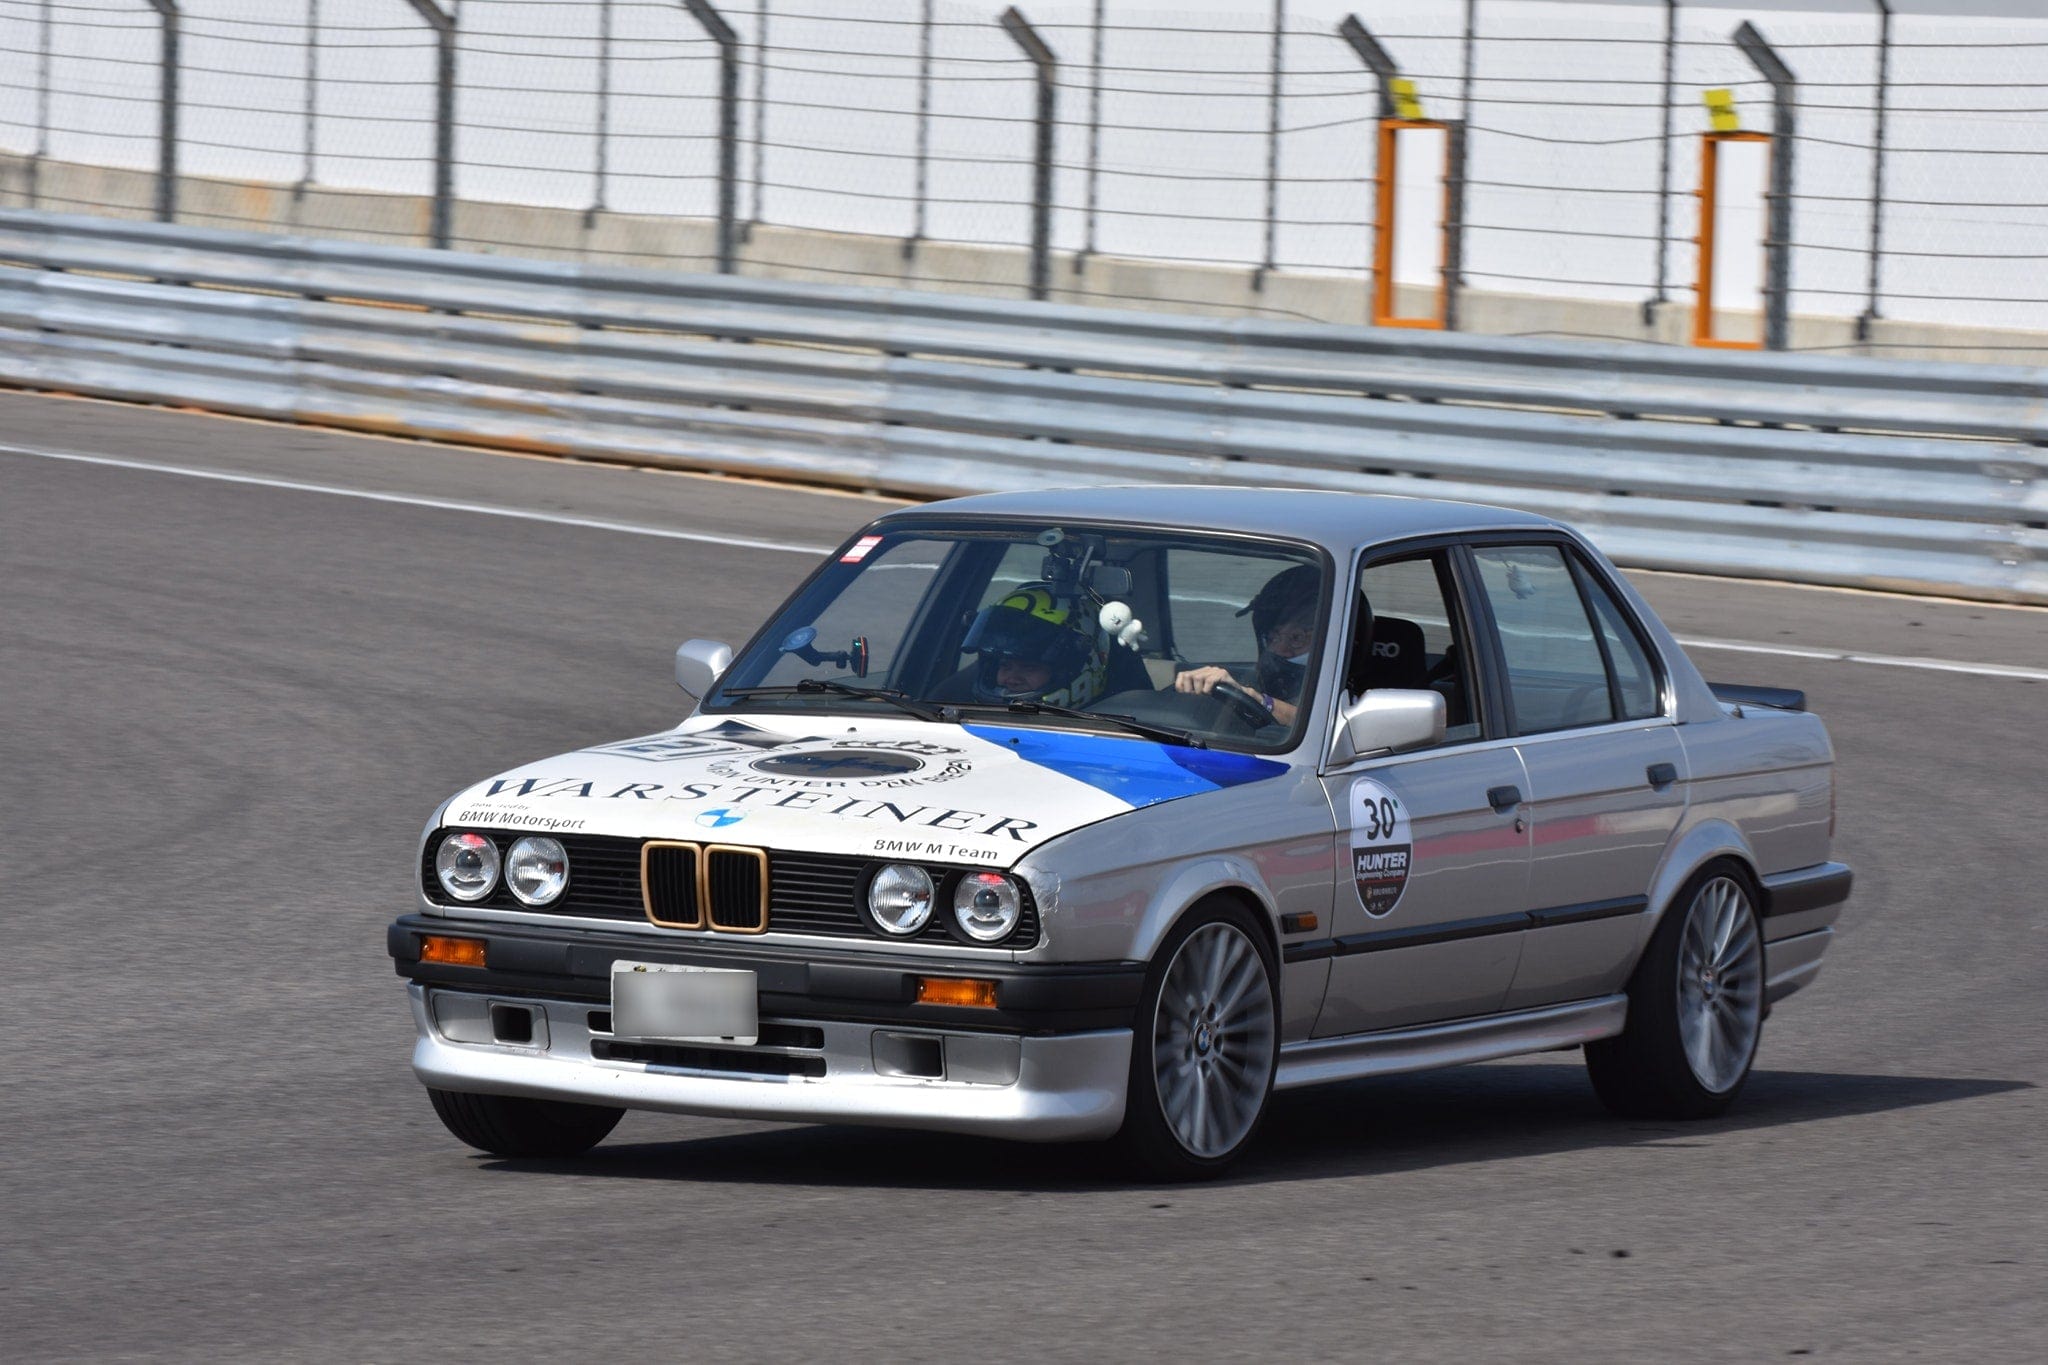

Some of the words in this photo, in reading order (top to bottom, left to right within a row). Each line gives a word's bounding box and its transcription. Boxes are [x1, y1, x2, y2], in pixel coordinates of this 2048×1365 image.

[459, 810, 499, 823] BMW
[498, 812, 586, 830] Motorsport
[485, 778, 1038, 843] WARSTEINER
[1363, 797, 1396, 841] 30
[873, 839, 922, 852] BMW
[925, 843, 943, 855] M
[948, 844, 999, 861] Team
[1356, 852, 1408, 871] HUNTER
